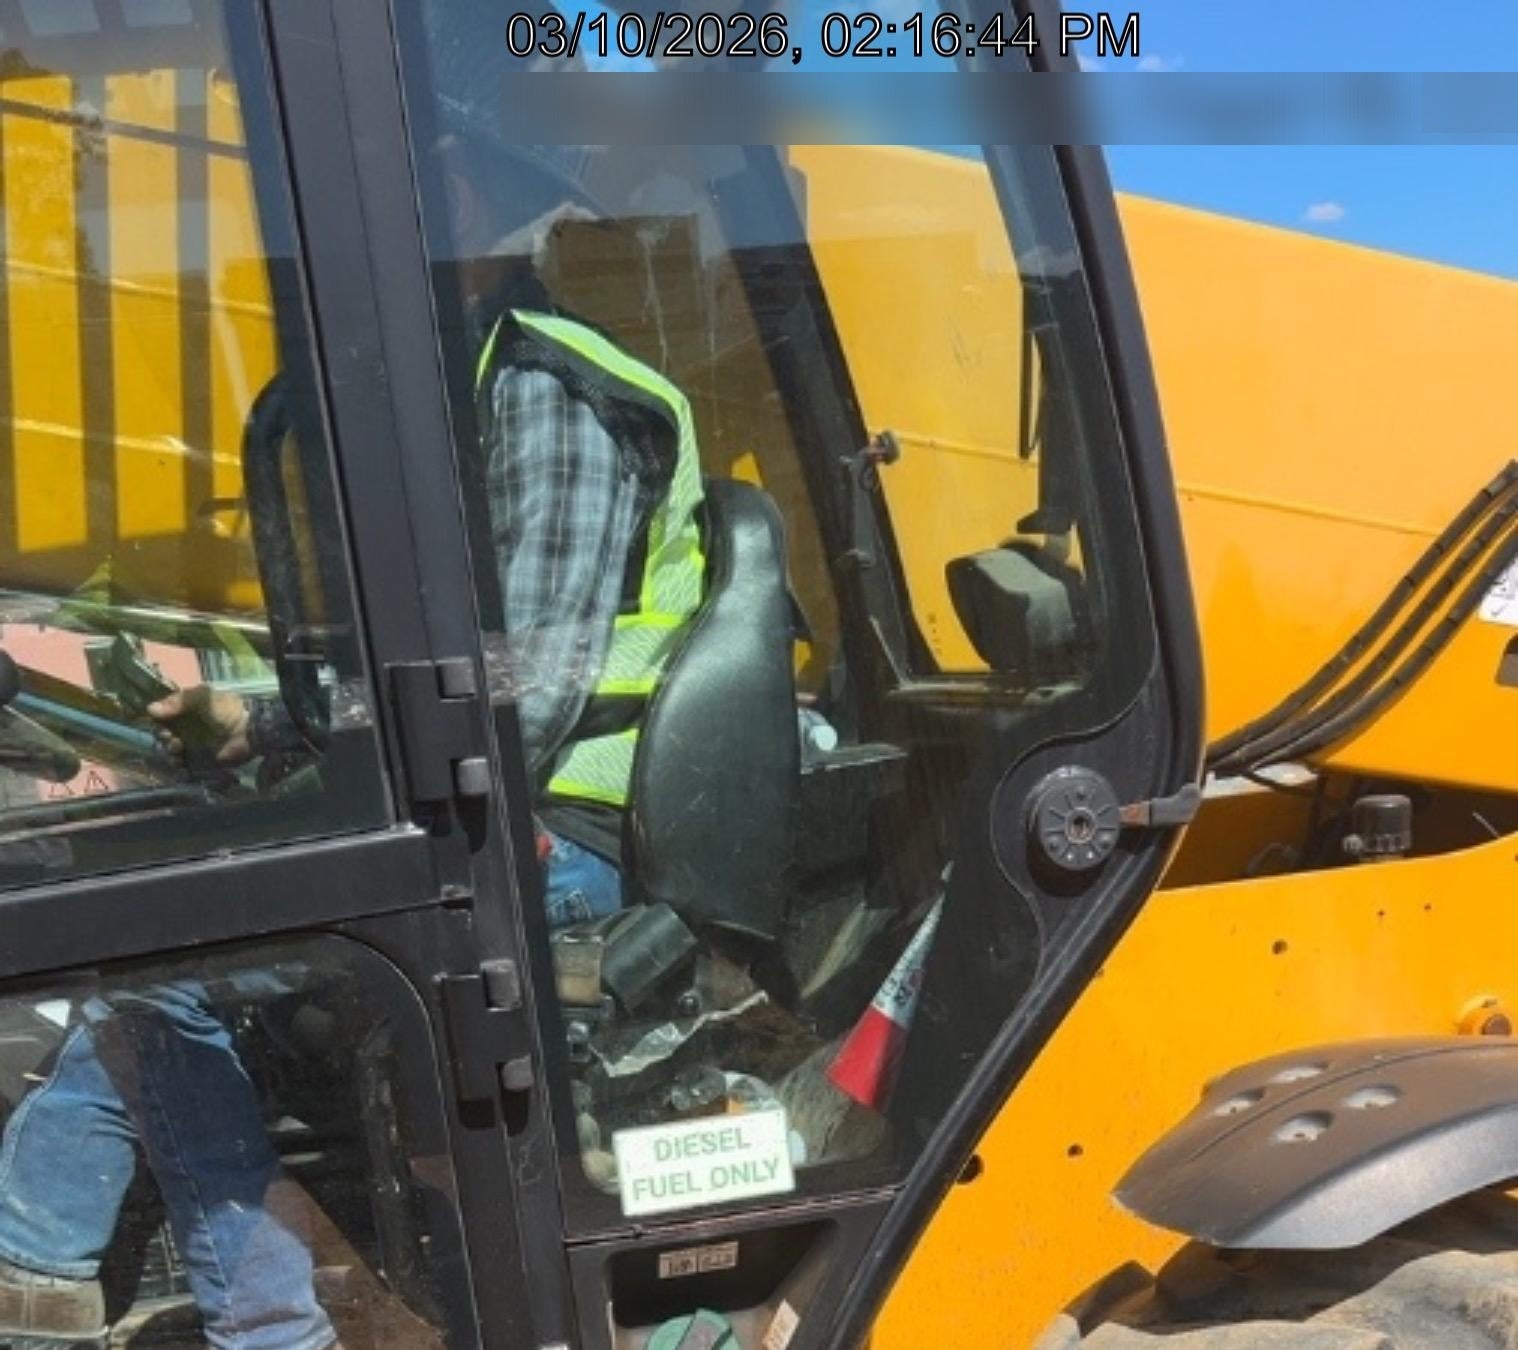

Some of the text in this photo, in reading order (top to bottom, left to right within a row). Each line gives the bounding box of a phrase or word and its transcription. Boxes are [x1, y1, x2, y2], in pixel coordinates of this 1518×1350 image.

[653, 1127, 752, 1162] DIESEL
[632, 1157, 779, 1201] FUEL ONLY
